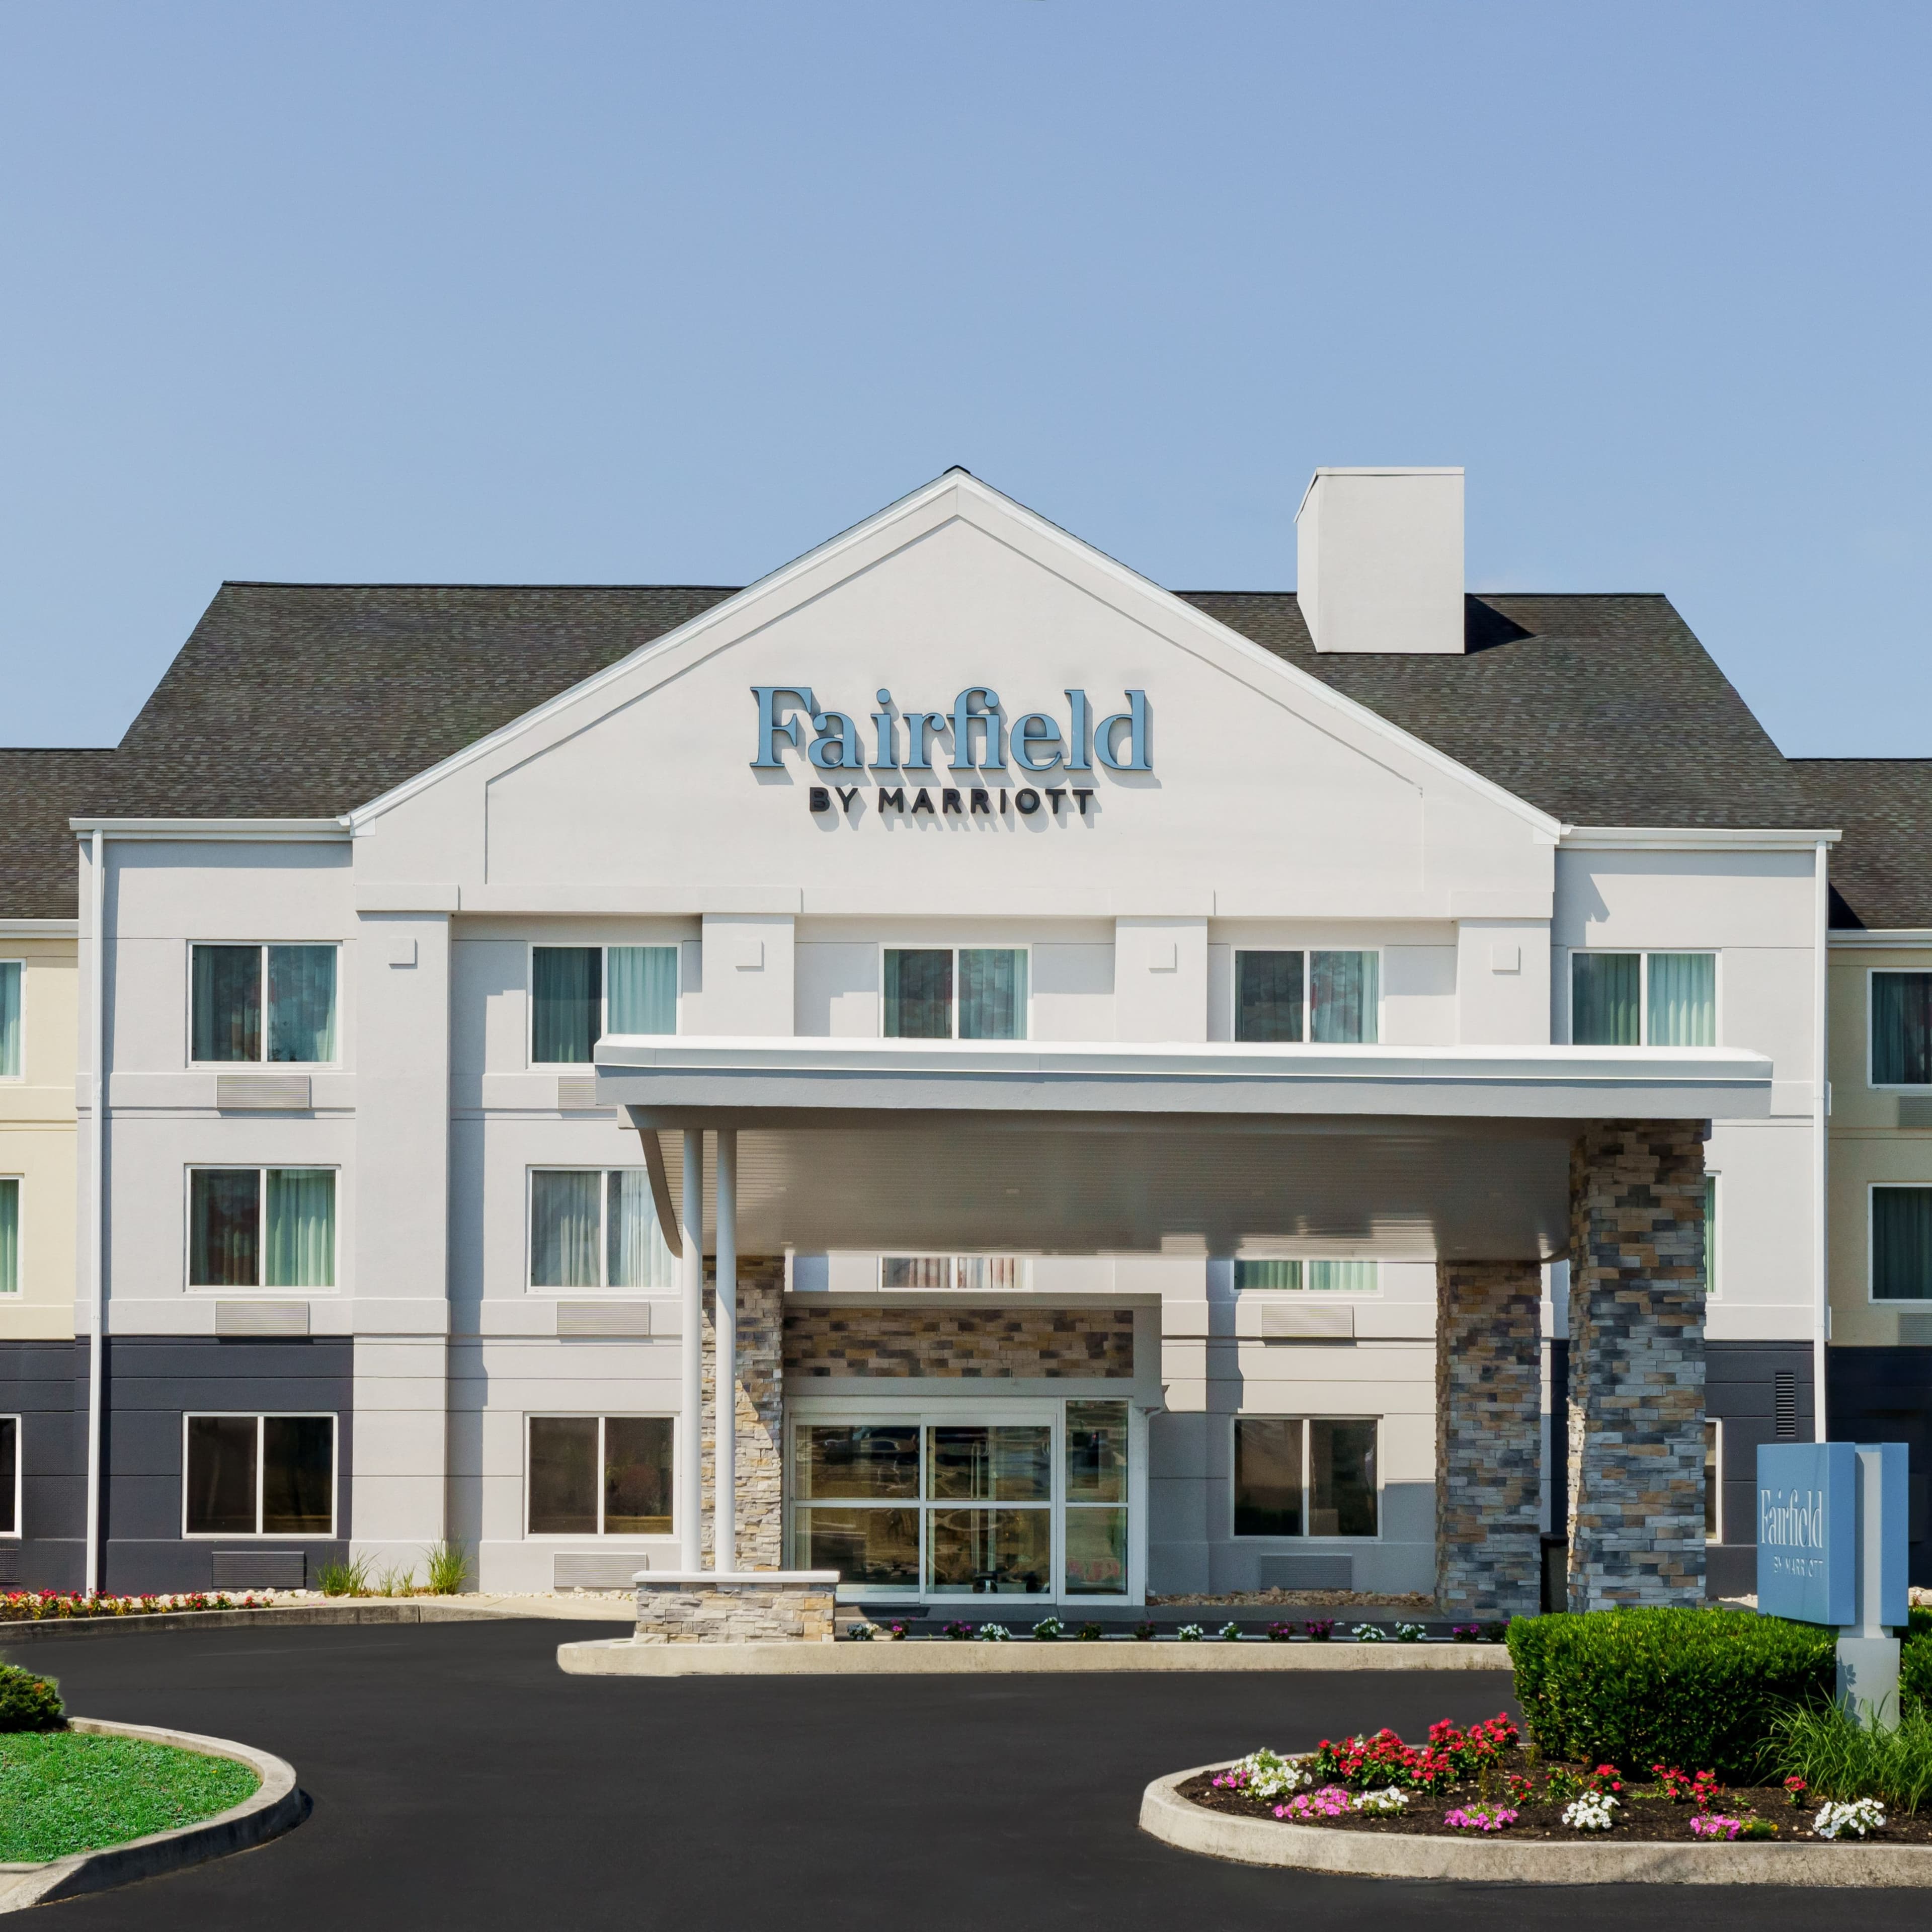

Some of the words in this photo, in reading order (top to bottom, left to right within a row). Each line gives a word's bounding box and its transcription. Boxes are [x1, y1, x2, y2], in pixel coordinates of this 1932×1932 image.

[750, 686, 1152, 770] Fairfield
[809, 787, 858, 812] BY
[878, 787, 1094, 815] MARRIOTT
[1760, 1489, 1822, 1548] Fairfield
[1786, 1557, 1823, 1578] MARROTT
